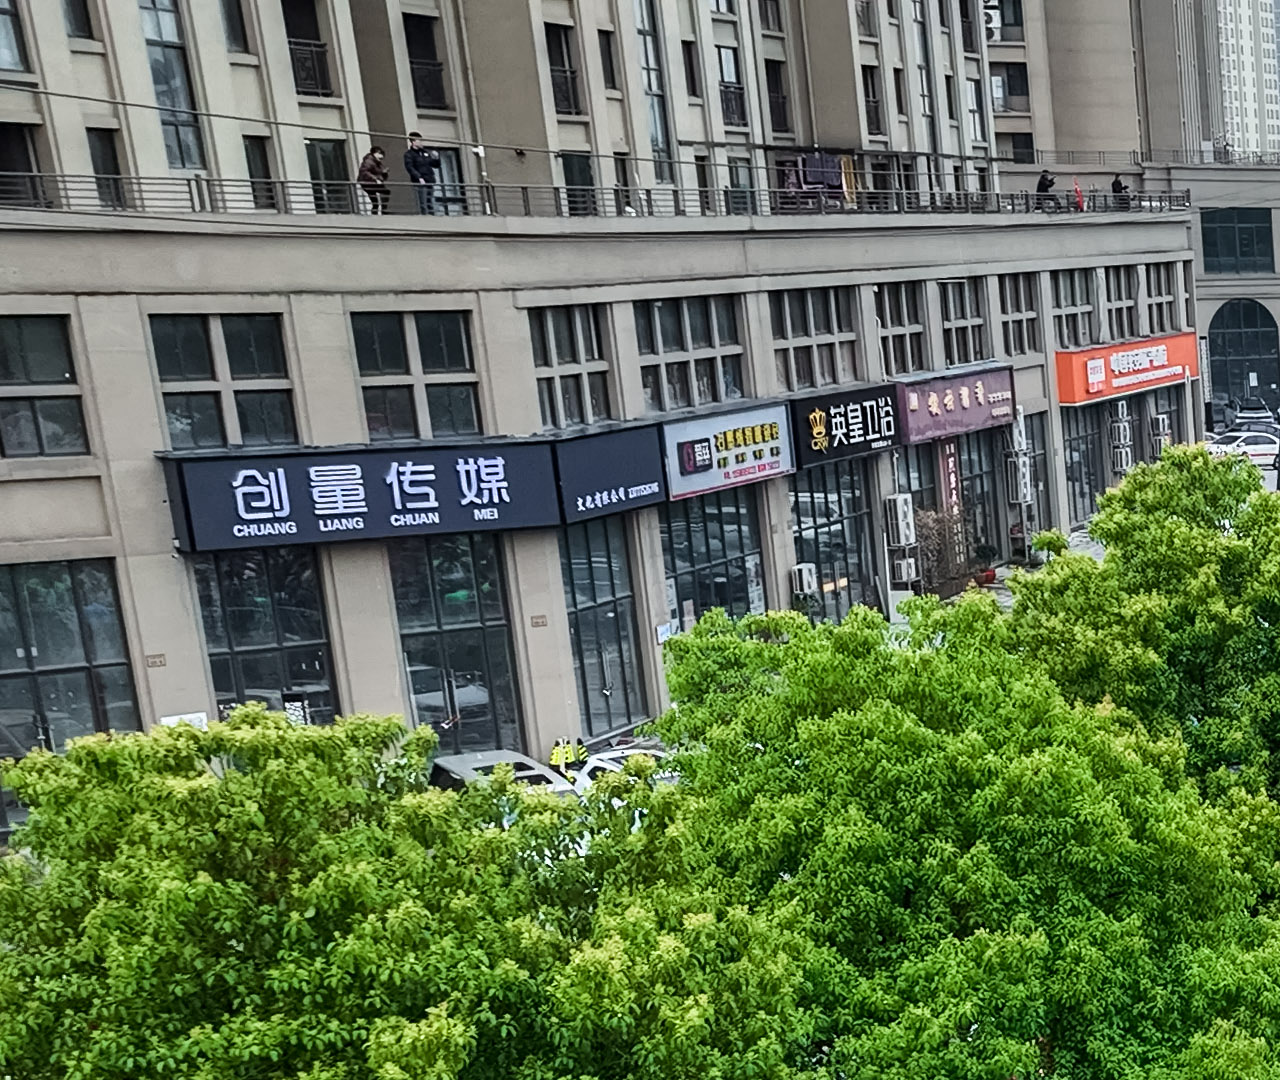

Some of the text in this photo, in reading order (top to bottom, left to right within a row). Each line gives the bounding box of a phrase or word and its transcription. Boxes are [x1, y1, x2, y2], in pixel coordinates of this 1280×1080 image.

[830, 397, 895, 447] 英皇卫浴
[232, 456, 510, 521] 创量传媒
[233, 506, 499, 537] CHUANG LIANG CHUAN MEI
